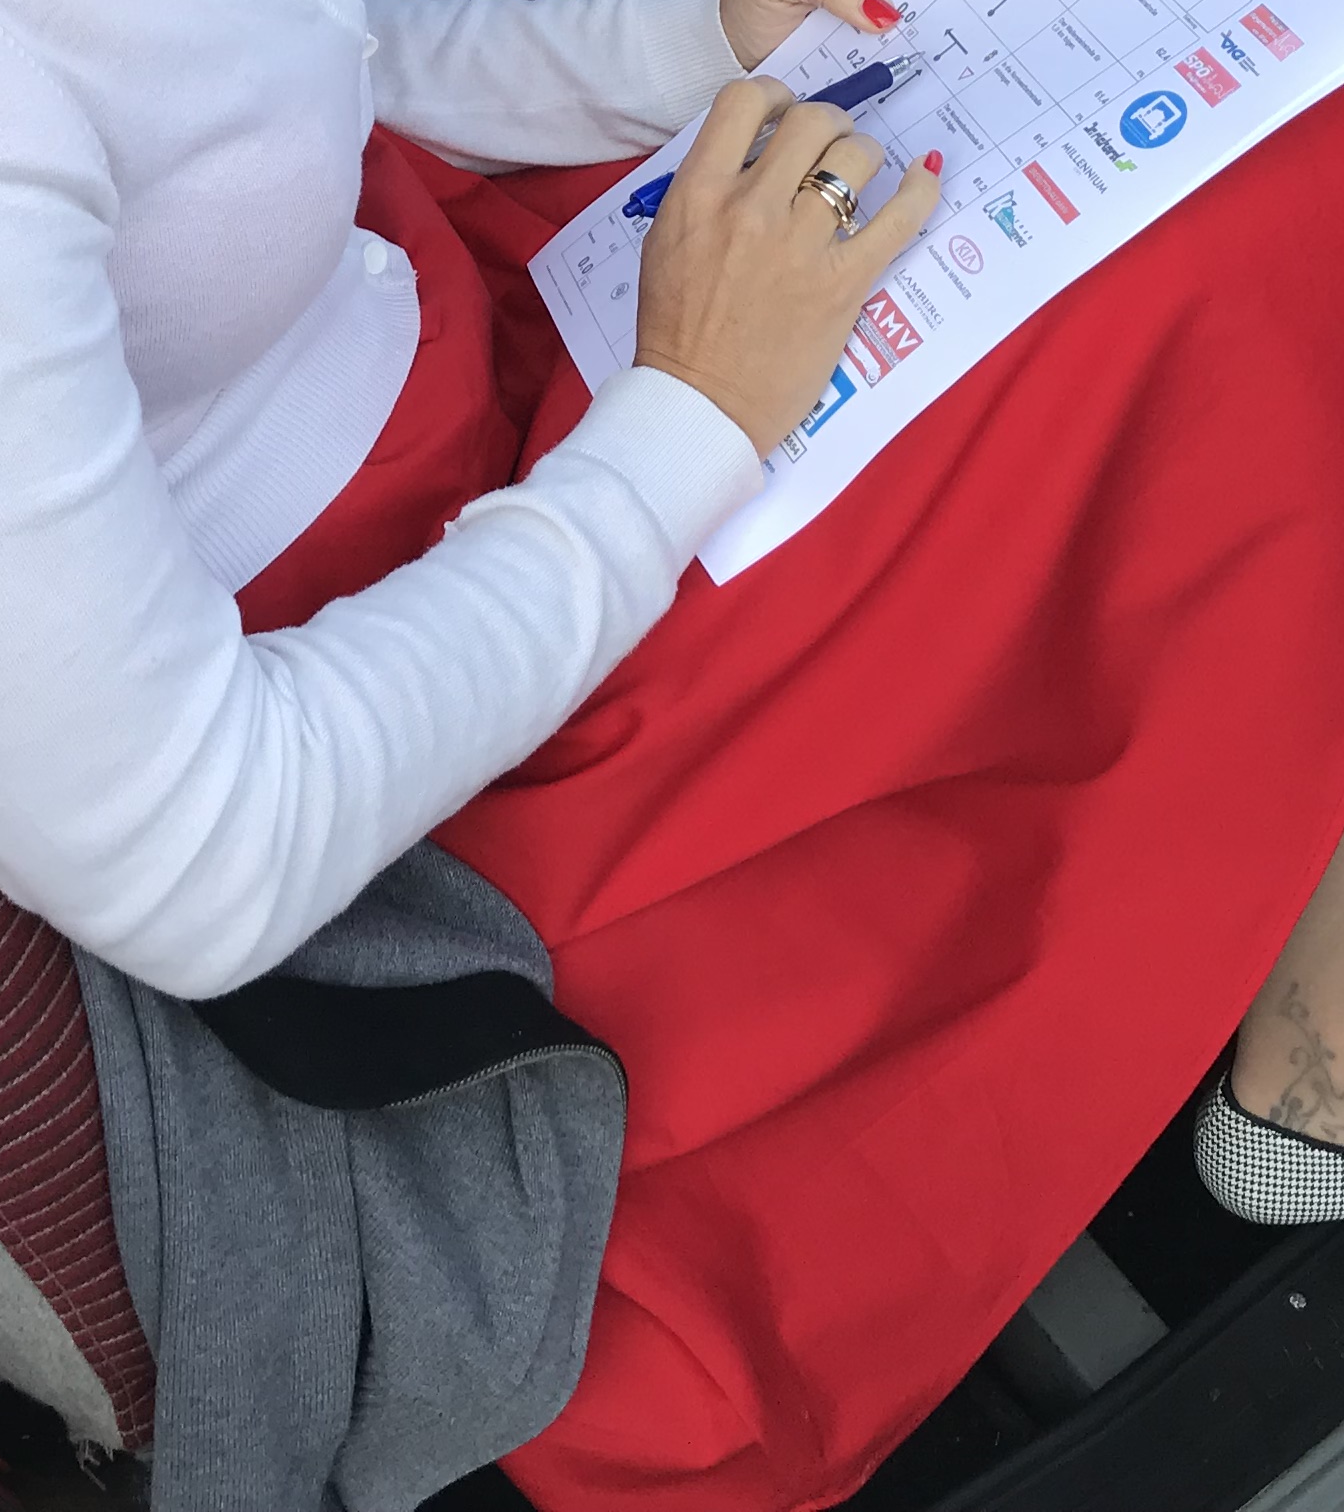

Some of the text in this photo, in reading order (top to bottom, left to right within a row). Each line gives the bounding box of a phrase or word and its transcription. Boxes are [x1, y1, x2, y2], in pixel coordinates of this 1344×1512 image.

[844, 47, 866, 69] 0.2
[1155, 46, 1170, 62] 62.4
[1183, 52, 1213, 79] SPÖ
[1093, 89, 1109, 105] 61.4
[1032, 132, 1048, 148] 61.4
[1060, 141, 1108, 194] MILLENNIUM
[972, 175, 987, 192] 61.2
[576, 255, 594, 275] 0.0
[954, 241, 976, 267] KIA
[926, 243, 972, 300] Autohaus WIMMER
[898, 267, 945, 325] LAMBERG
[865, 299, 919, 350] AMV
